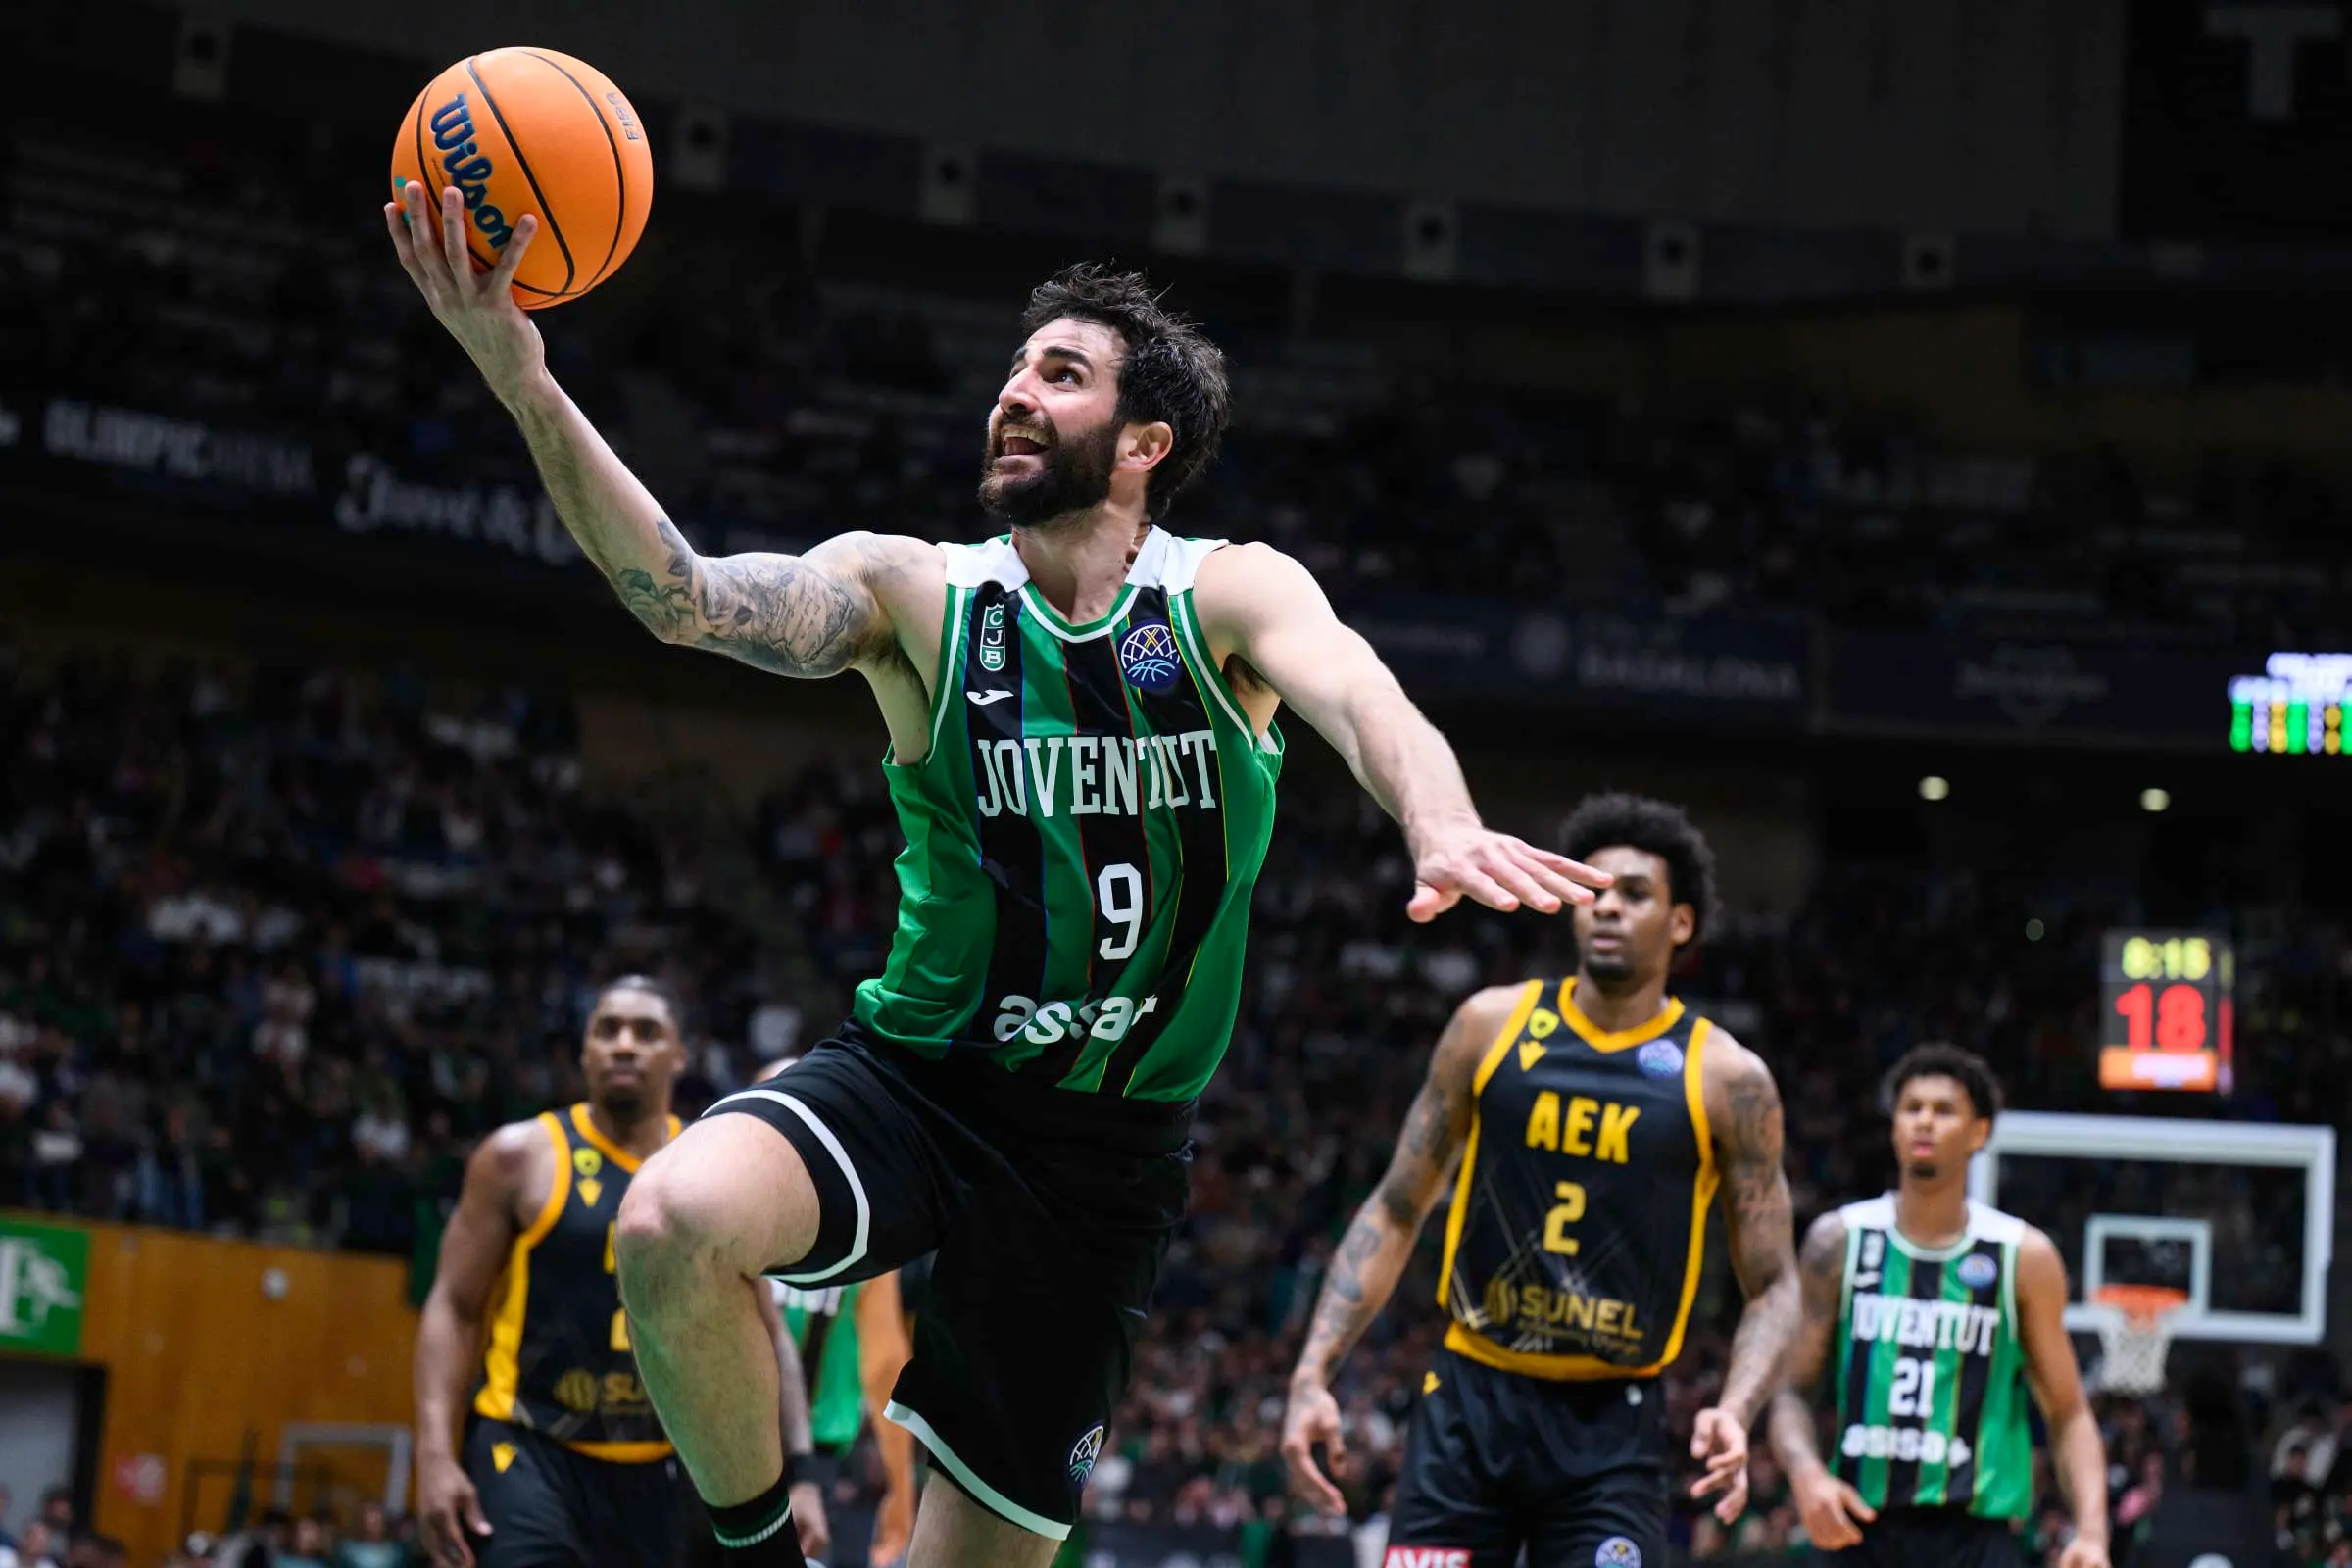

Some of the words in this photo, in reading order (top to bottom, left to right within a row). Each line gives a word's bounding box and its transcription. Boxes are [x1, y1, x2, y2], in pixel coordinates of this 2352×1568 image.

[977, 729, 1218, 817] JOVENTUT
[1097, 862, 1144, 961] 9
[993, 994, 1135, 1045] asa
[2114, 982, 2207, 1053] 18
[1525, 1090, 1642, 1165] AEK
[1543, 1179, 1588, 1257] 2
[1519, 1283, 1645, 1341] SUNEL
[1888, 1356, 1936, 1419] 21
